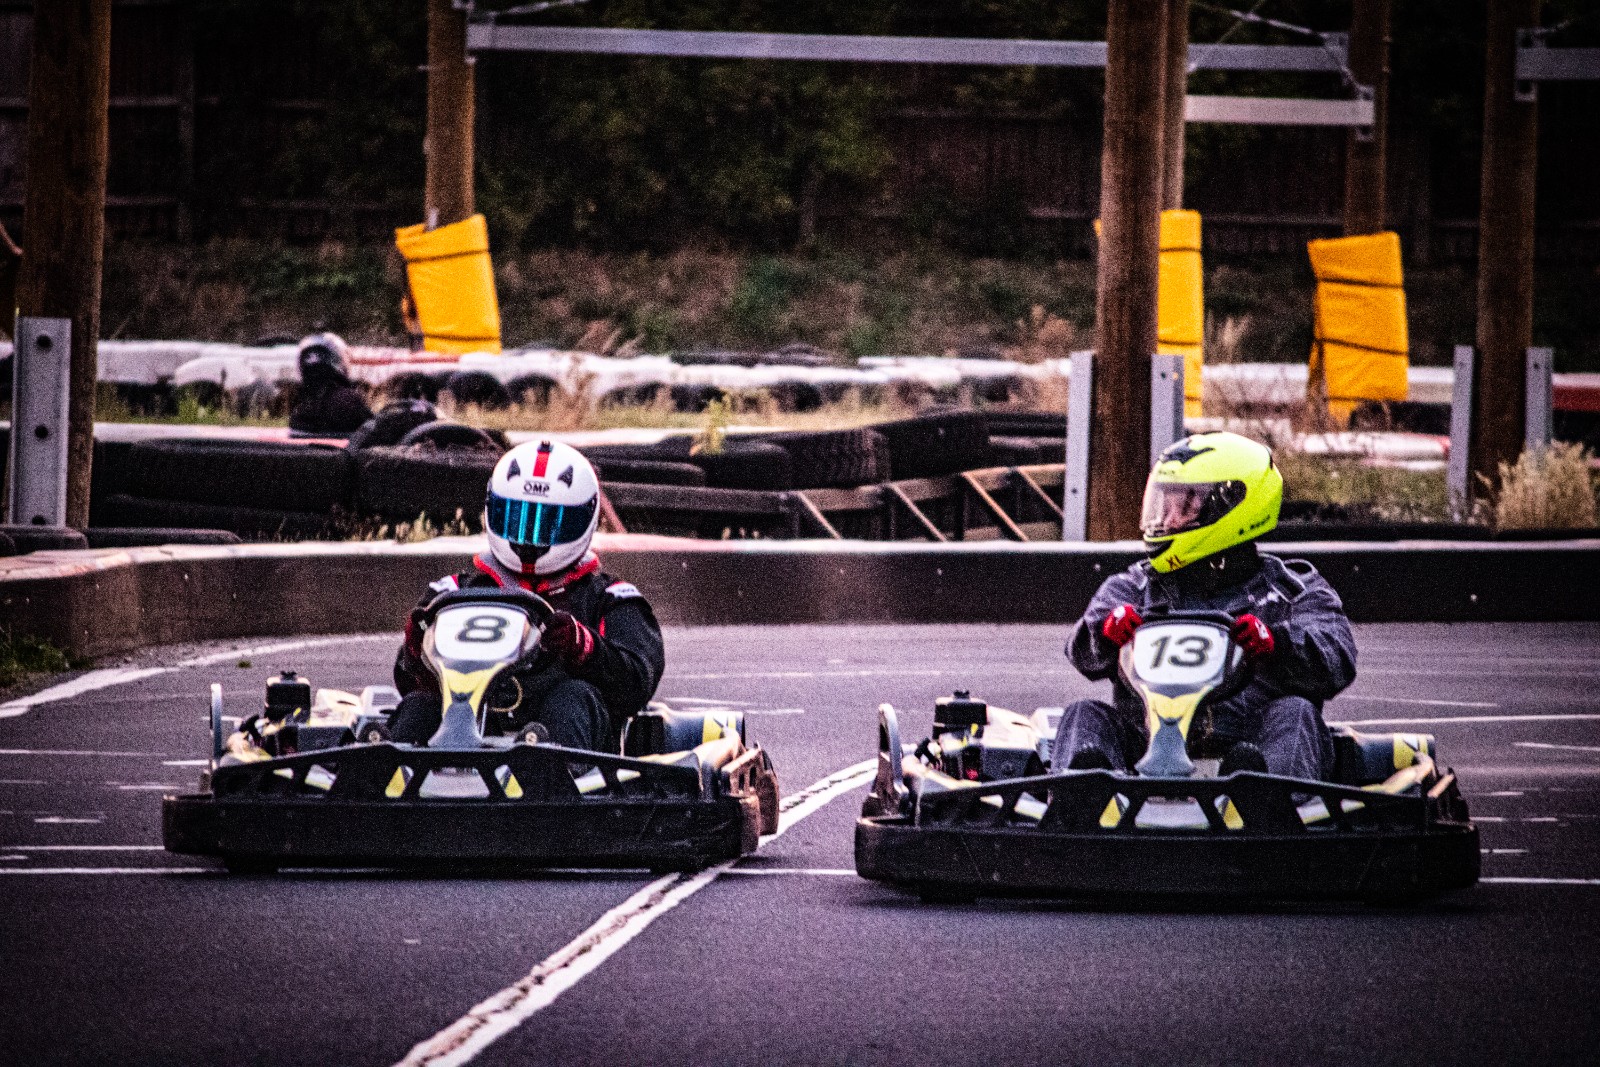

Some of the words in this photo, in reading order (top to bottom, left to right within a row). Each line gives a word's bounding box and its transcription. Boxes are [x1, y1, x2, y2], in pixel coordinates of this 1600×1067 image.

[523, 483, 550, 493] OMP
[1166, 555, 1186, 570] XL
[456, 615, 510, 642] 8
[1150, 635, 1213, 669] 13
